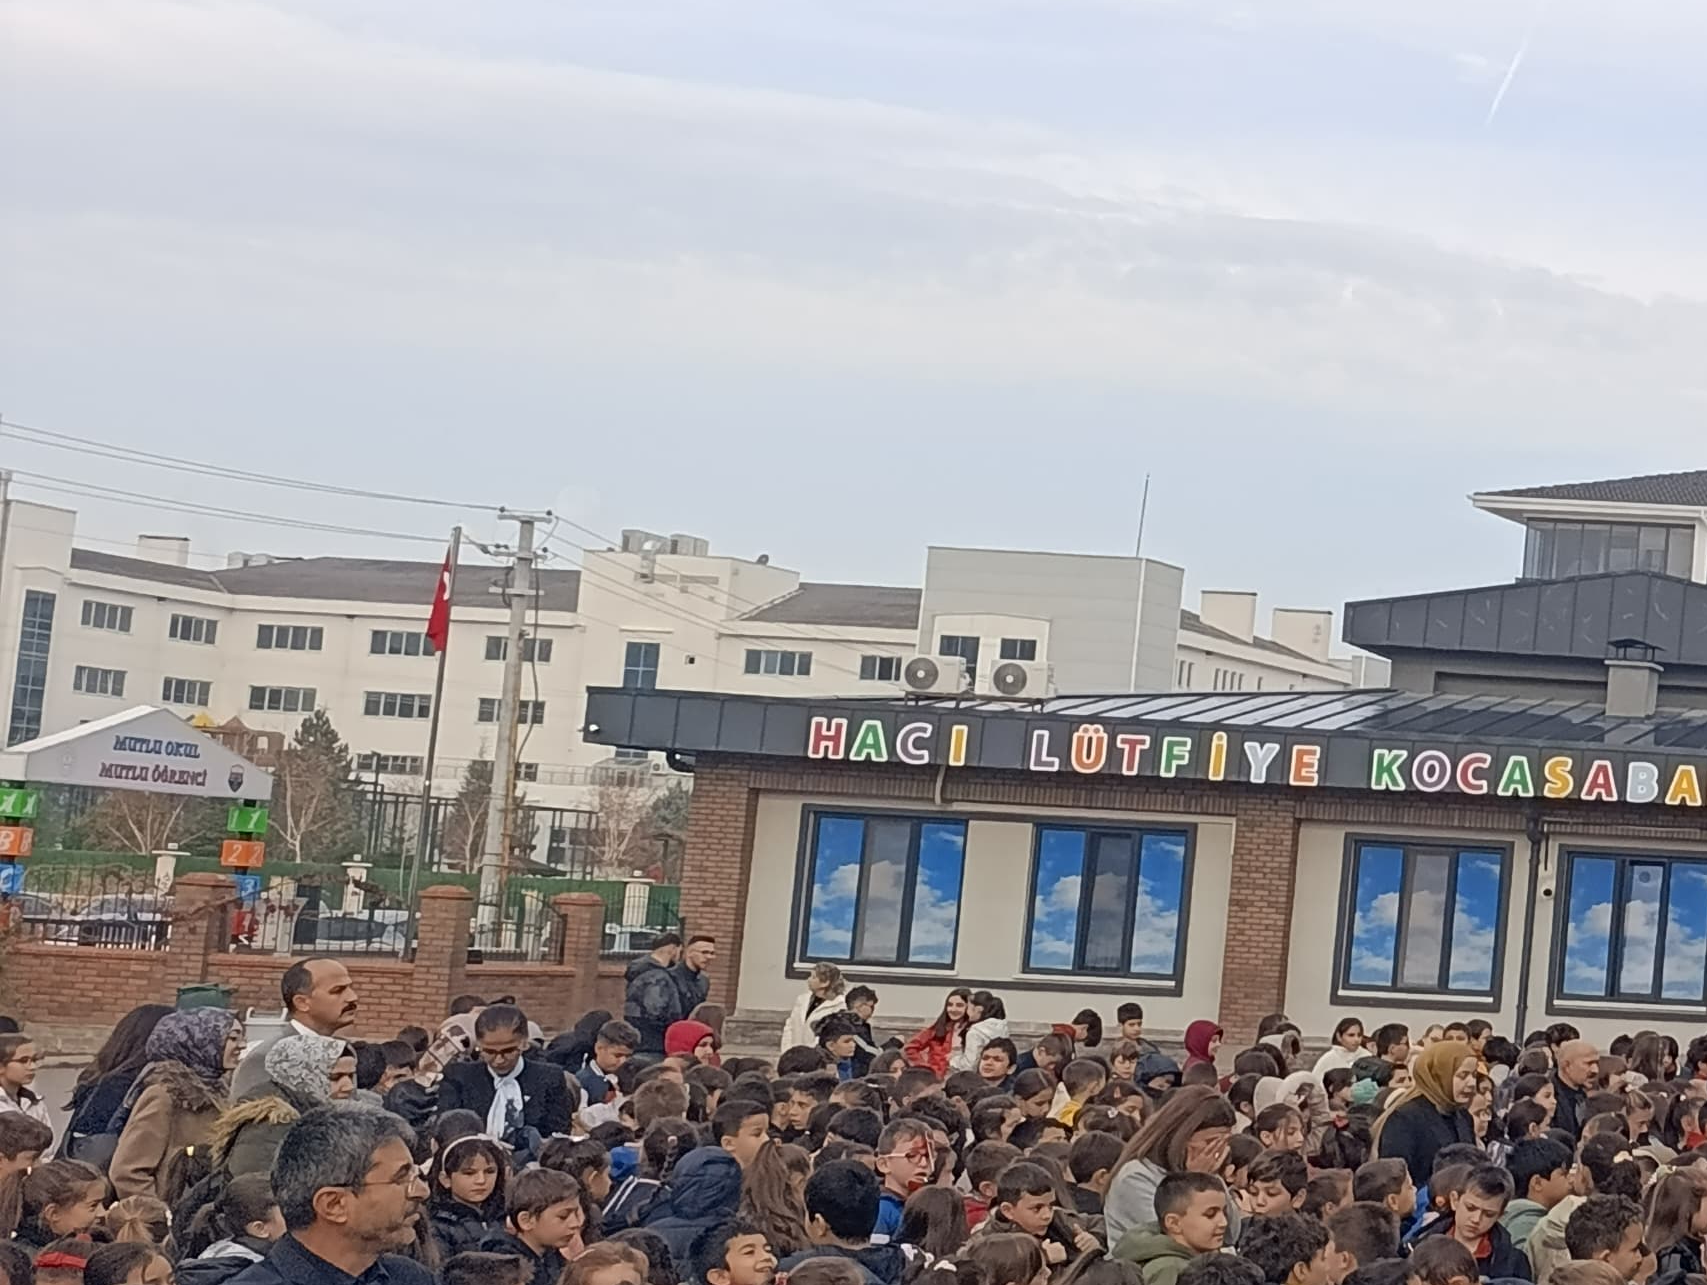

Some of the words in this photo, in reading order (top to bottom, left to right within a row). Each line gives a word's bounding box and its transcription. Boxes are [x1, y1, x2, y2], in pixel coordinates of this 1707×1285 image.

[113, 735, 163, 754] MUTLU
[165, 741, 201, 758] OKUL
[807, 716, 969, 767] HACI
[1029, 723, 1321, 787] LÜTFİYE
[99, 762, 149, 782] MUTLU
[152, 764, 208, 787] ÖĞRENCİ
[228, 844, 242, 863] 2
